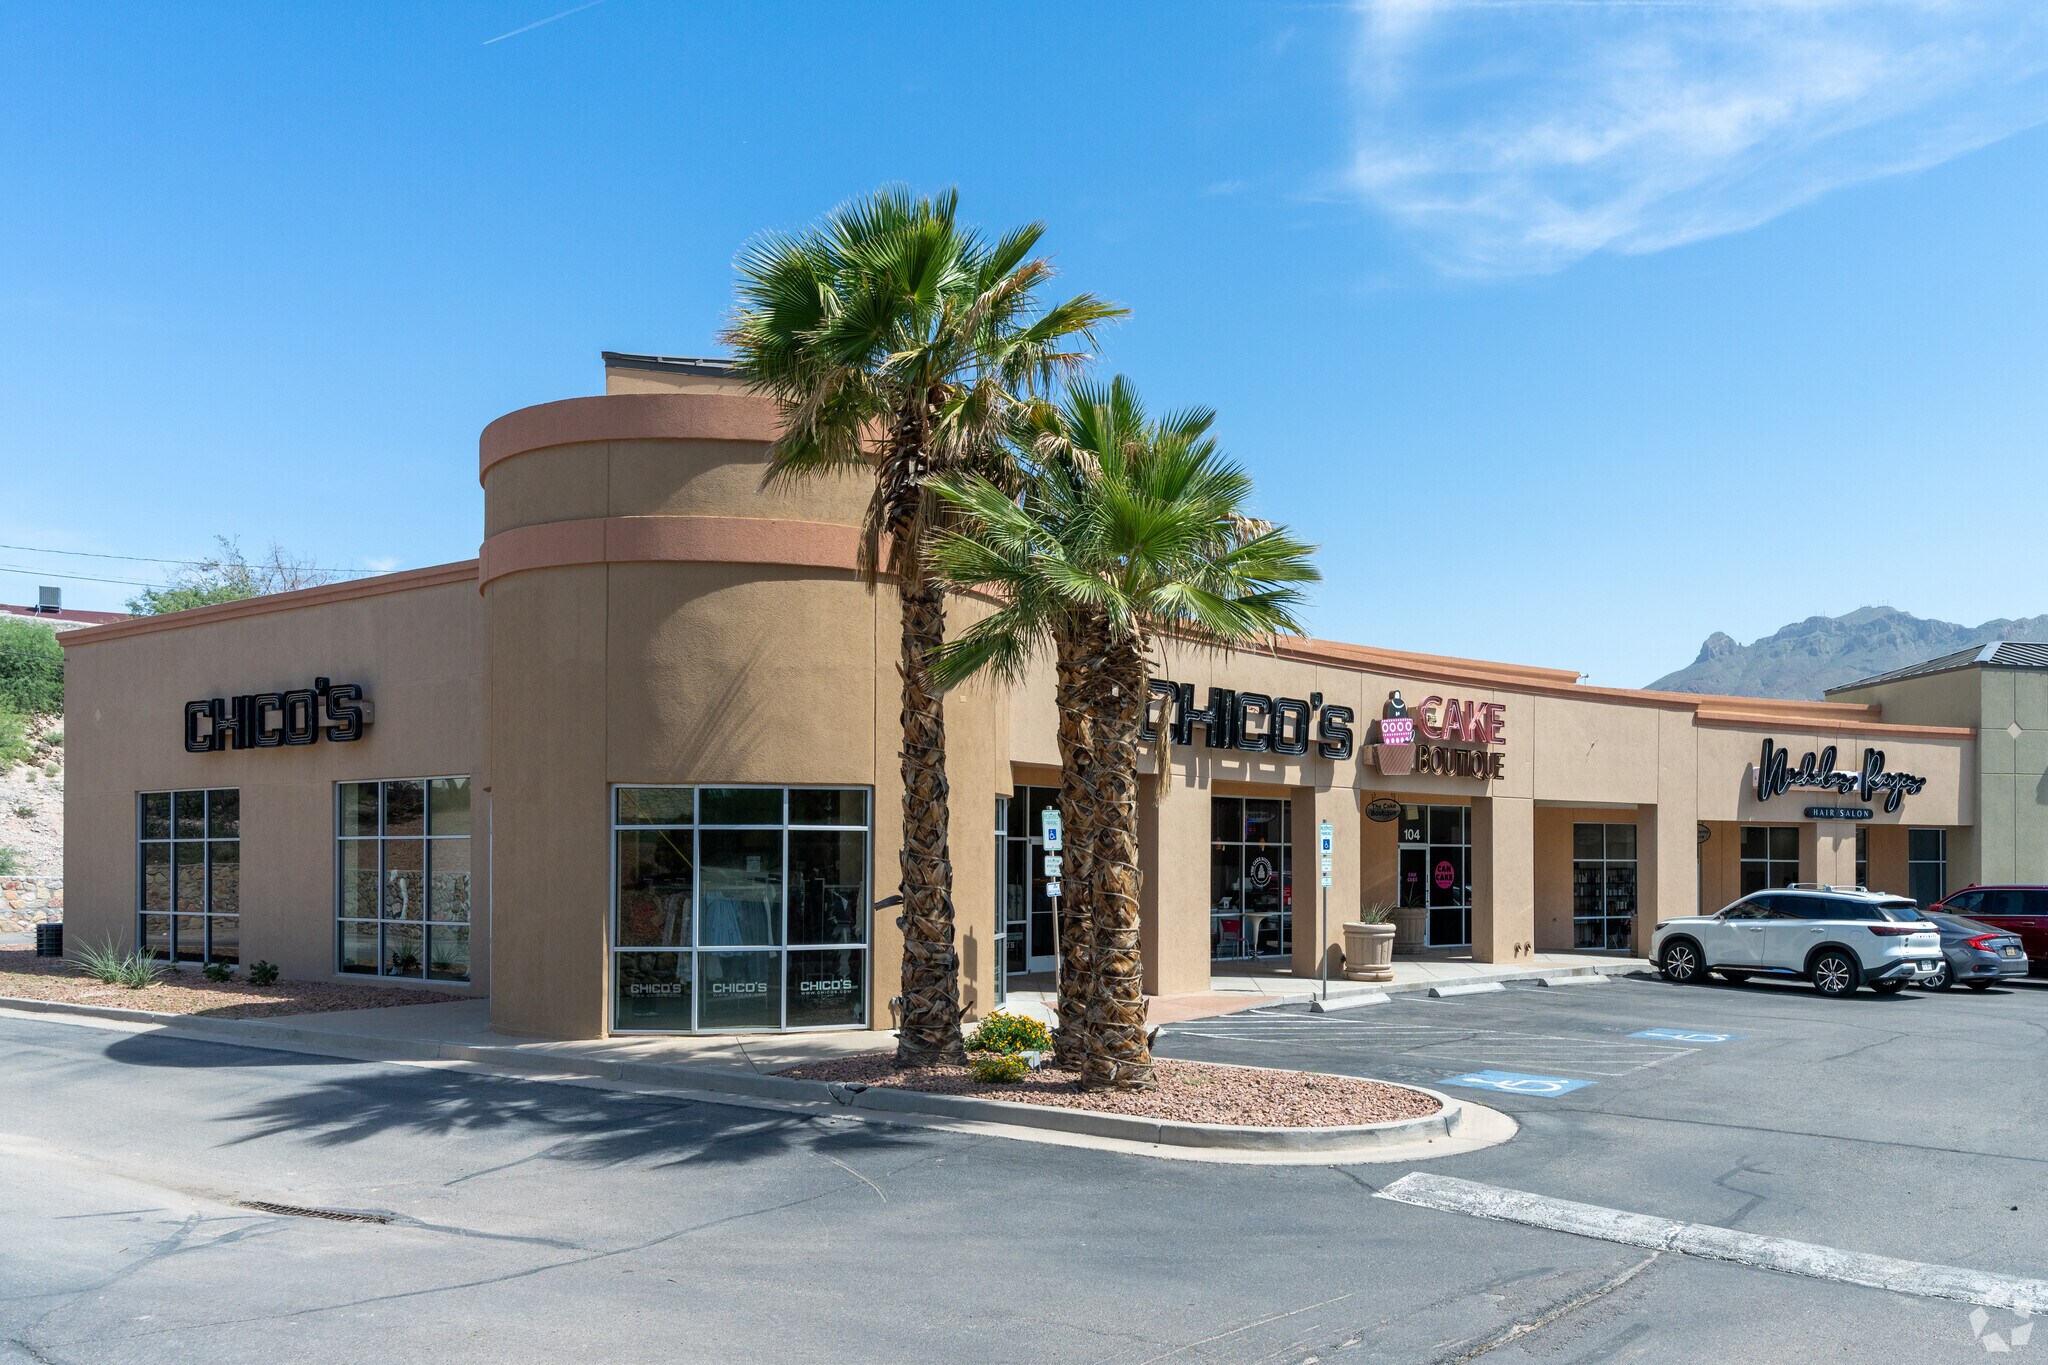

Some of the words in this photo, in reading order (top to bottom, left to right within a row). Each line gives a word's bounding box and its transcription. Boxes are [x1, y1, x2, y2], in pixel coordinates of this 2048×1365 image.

[185, 677, 362, 752] CHICO'S
[1139, 677, 1355, 760] CHICO'S
[1416, 696, 1506, 745] CAKE
[1415, 745, 1505, 780] BOUTIQUE
[1757, 738, 1858, 802] Nicholas
[1813, 808, 1835, 816] HAIR
[1840, 809, 1869, 817] SALON
[1403, 829, 1420, 840] 104
[630, 983, 681, 993] CHICO'S
[713, 981, 767, 993] CHICO'S
[800, 979, 852, 991] CHICO'S
